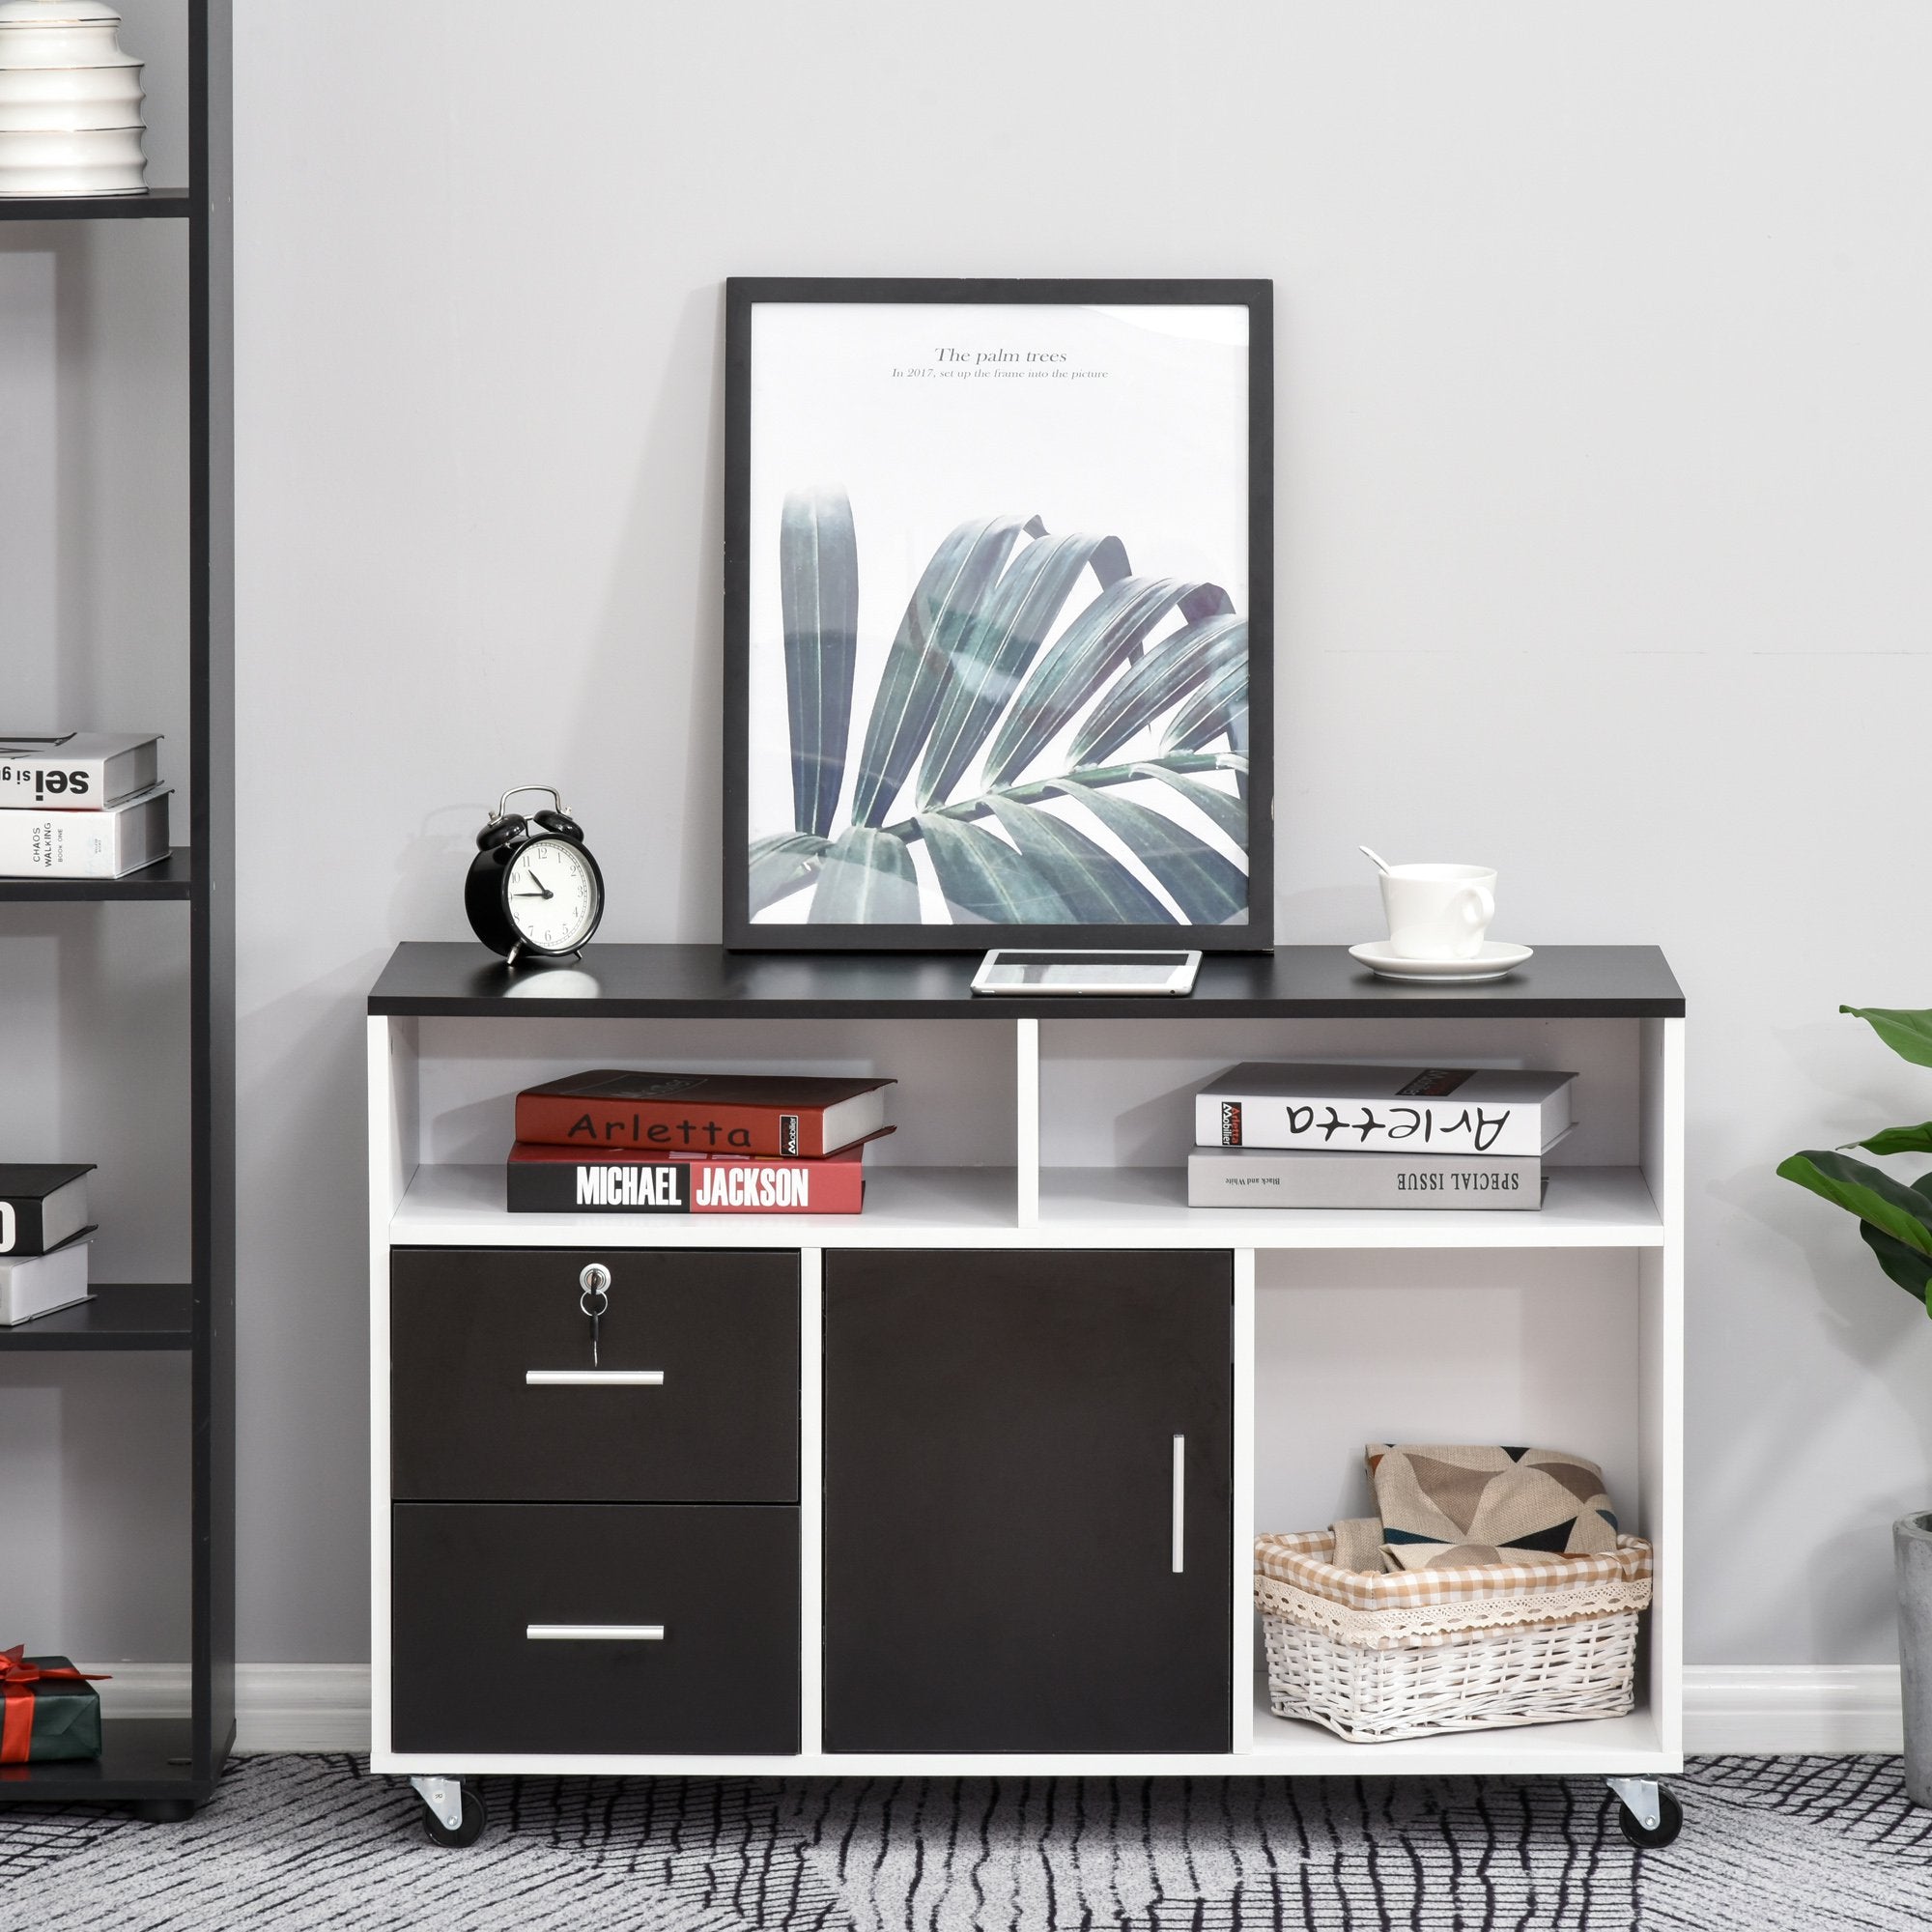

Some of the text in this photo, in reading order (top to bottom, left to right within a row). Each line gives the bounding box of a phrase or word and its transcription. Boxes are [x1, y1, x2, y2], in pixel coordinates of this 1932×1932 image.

[935, 348, 1067, 365] The palm trees
[892, 368, 903, 378] In
[908, 368, 936, 379] 2017,
[957, 370, 972, 379] up
[974, 369, 991, 378] the
[994, 369, 1025, 378] frame
[1028, 369, 1049, 378] into
[1051, 369, 1068, 378] the
[1071, 369, 1109, 380] picture
[36, 770, 90, 801] sei
[32, 827, 41, 863] CHAOS
[43, 822, 52, 867] WALKING
[537, 848, 548, 860] 12
[557, 852, 561, 864] 1
[522, 855, 531, 867] 11
[511, 871, 521, 884] 10
[570, 866, 577, 877] 2
[577, 886, 583, 897] 3
[513, 912, 520, 923] 8
[573, 906, 579, 918] 4
[527, 924, 534, 937] 7
[544, 930, 552, 942] 6
[562, 923, 569, 936] 5
[1222, 1102, 1233, 1145] Mobilier
[1286, 1105, 1511, 1151] Arletta
[567, 1113, 752, 1148] Arletta
[576, 1166, 809, 1208] MICHAEL JACKSON
[1397, 1173, 1520, 1191] SPECIAL ISSUE
